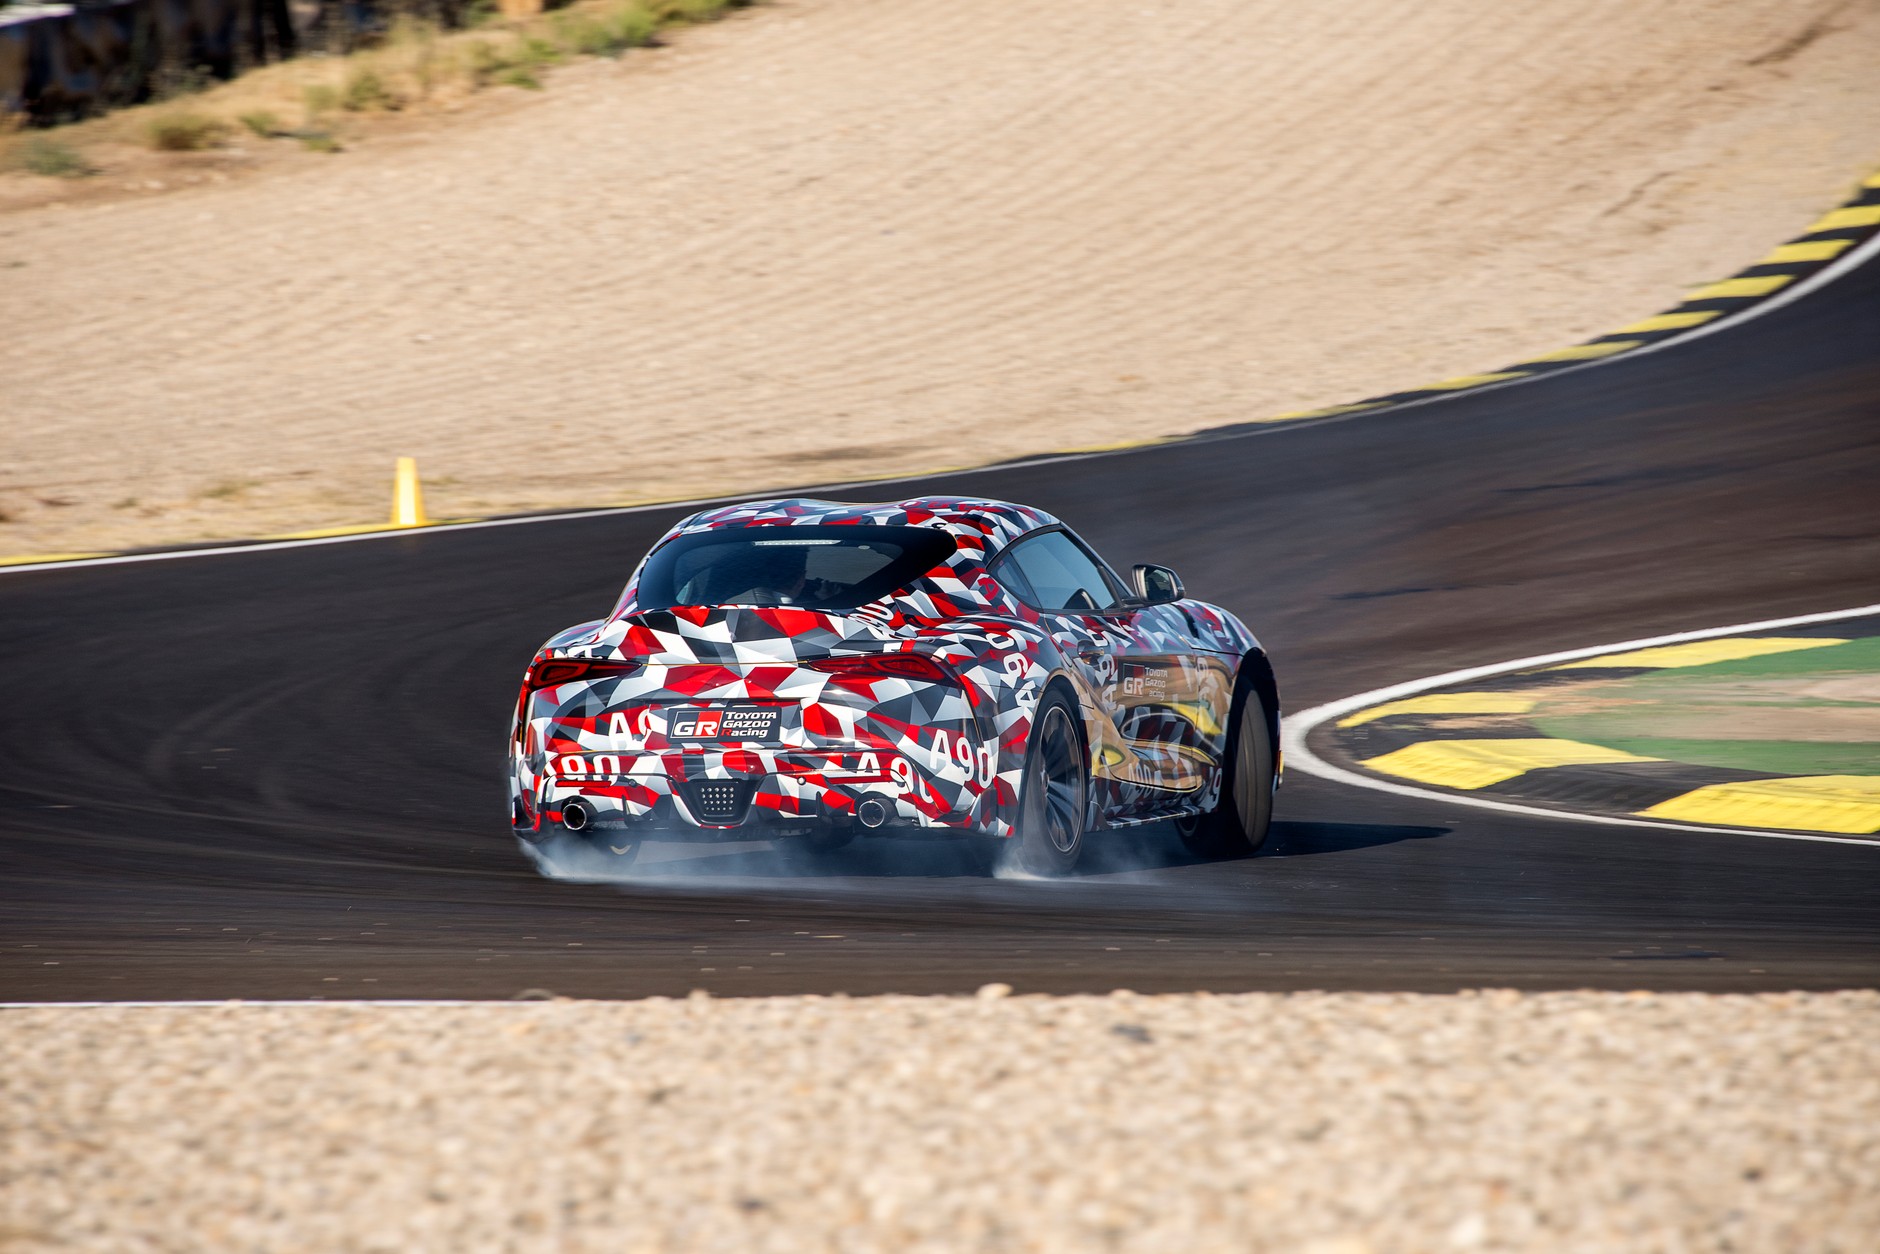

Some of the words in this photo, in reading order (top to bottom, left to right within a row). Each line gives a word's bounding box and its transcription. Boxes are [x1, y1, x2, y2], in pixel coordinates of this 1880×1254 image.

[1145, 667, 1168, 677] TOYOTA
[1124, 676, 1143, 696] GR
[1145, 677, 1166, 688] GAZOO
[1147, 689, 1166, 701] acing
[725, 712, 777, 720] TOYOTA
[671, 720, 719, 737] GR
[722, 720, 771, 729] GAZOO
[720, 728, 769, 738] Racing
[929, 729, 996, 789] A90
